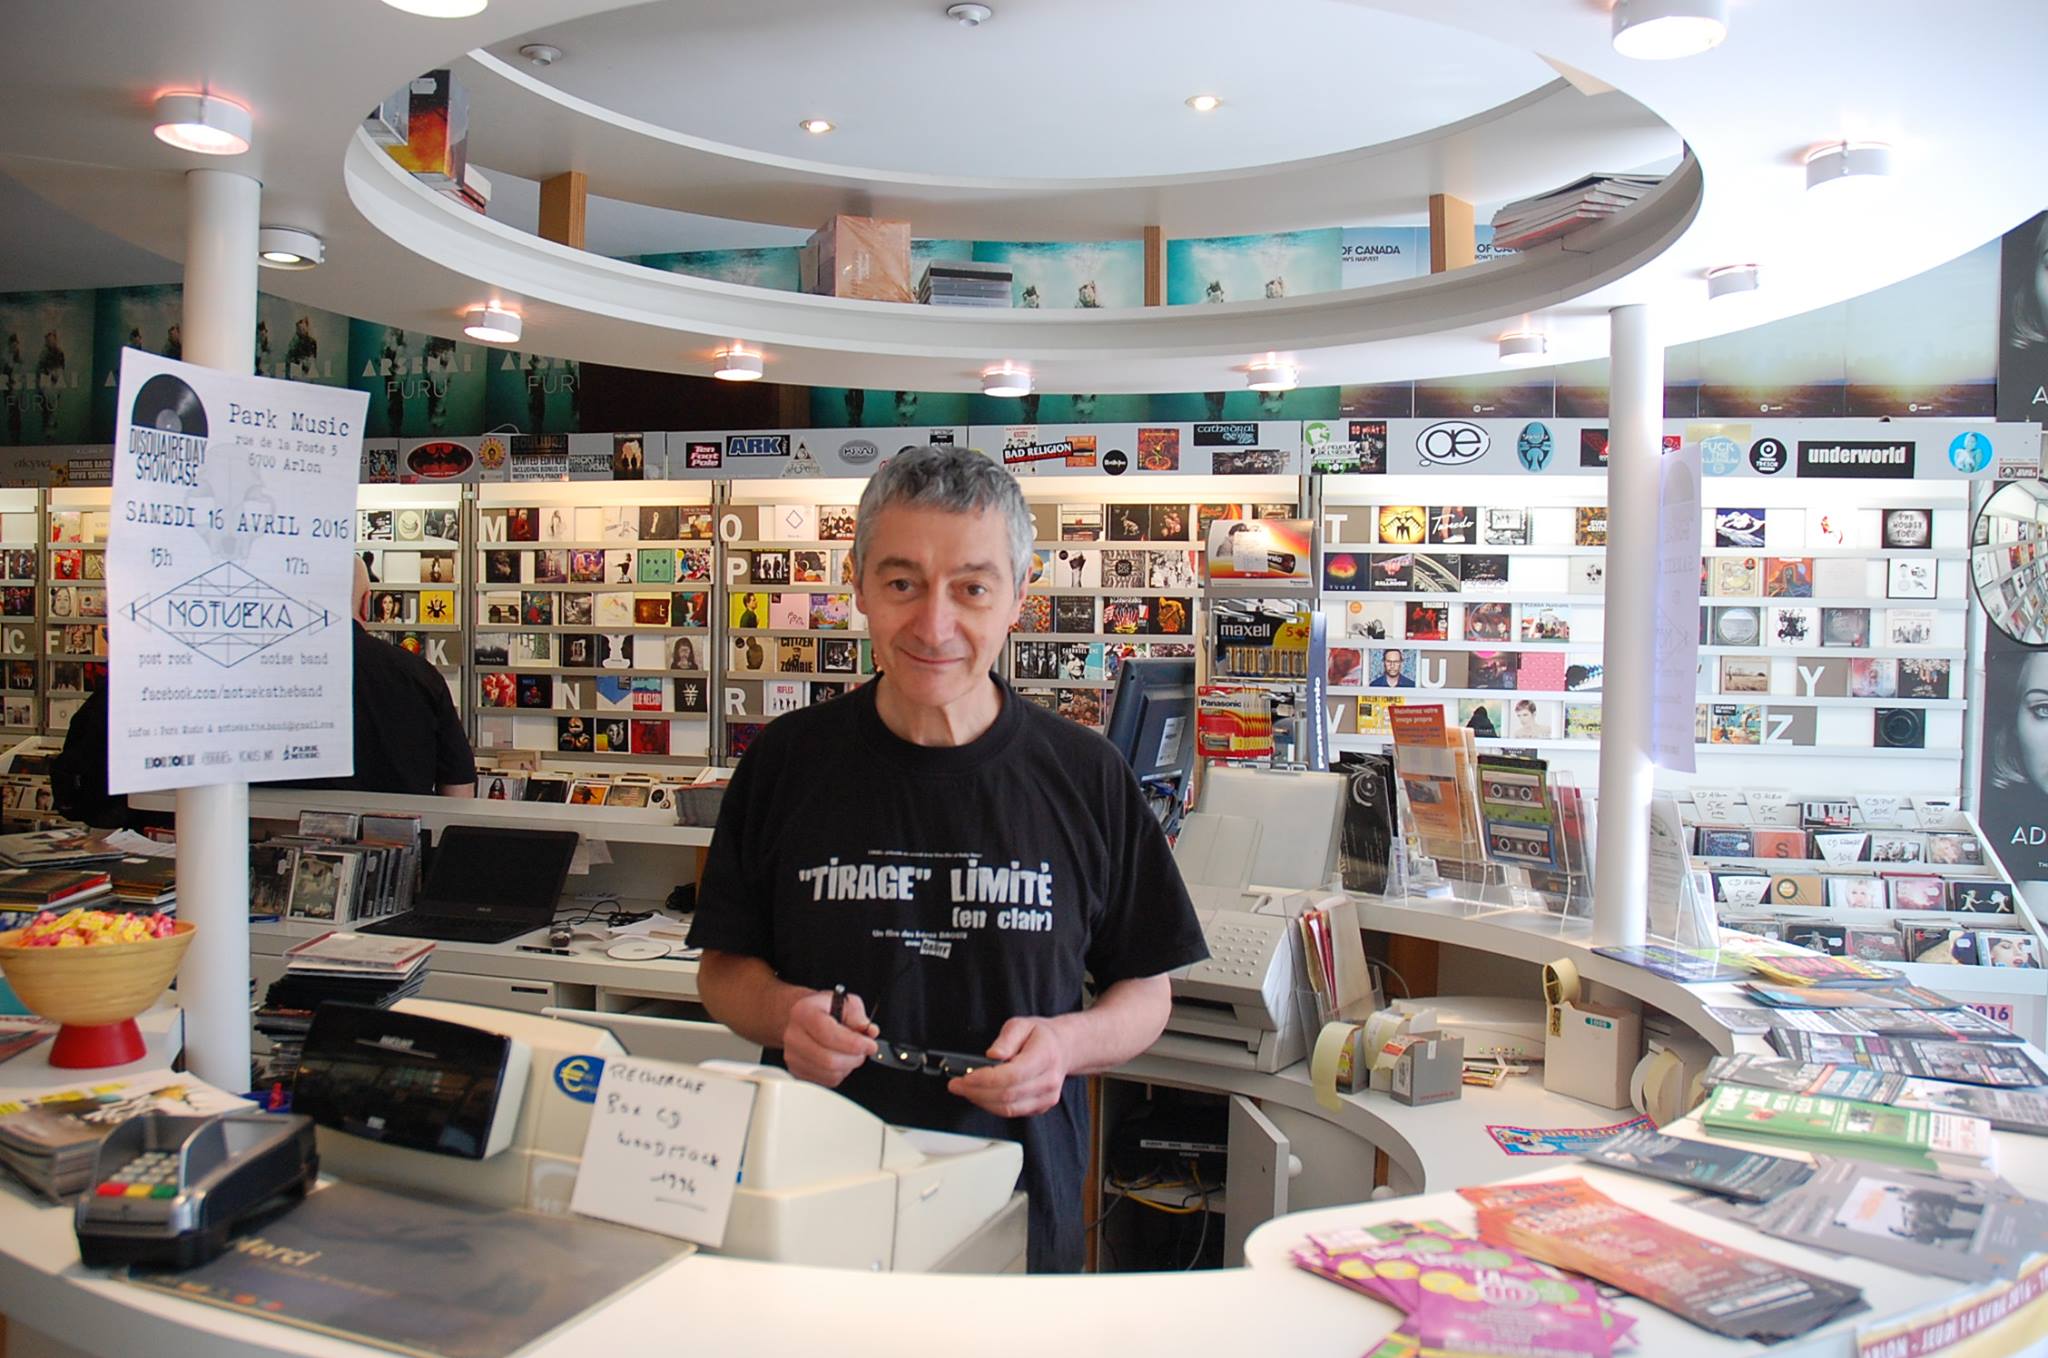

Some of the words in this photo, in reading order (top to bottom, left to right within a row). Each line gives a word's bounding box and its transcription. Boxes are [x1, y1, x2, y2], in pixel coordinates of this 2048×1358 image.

[1355, 245, 1400, 255] CANADA
[1476, 244, 1493, 253] OF
[528, 375, 580, 395] FUR
[229, 403, 277, 429] Park
[291, 412, 350, 437] Music
[235, 435, 254, 446] rue
[260, 436, 272, 448] de
[278, 439, 291, 451] la
[297, 440, 325, 455] Poste
[331, 445, 338, 456] 5
[729, 437, 781, 455] ARK
[1004, 449, 1025, 459] BAD
[1027, 443, 1072, 457] RELIGION
[1808, 445, 1906, 465] underworld
[136, 455, 199, 487] SHOWCASE
[248, 454, 277, 470] 6700
[284, 460, 323, 475] Arlon
[540, 455, 567, 465] EDITION
[126, 501, 196, 529] SAMEDI
[209, 509, 225, 531] 16
[237, 512, 300, 536] AVRIL
[312, 518, 350, 540] 2016
[482, 516, 507, 542] M
[720, 513, 742, 542] O
[1325, 514, 1348, 544] T
[151, 548, 173, 567] 15h
[286, 557, 311, 576] 17h
[727, 557, 748, 585] P
[405, 598, 417, 624] J
[8, 630, 26, 654] C
[46, 631, 61, 654] F
[1220, 623, 1271, 638] maxell
[427, 639, 449, 666] K
[780, 638, 815, 648] CITIZEN
[138, 653, 164, 666] post
[168, 652, 194, 665] rock
[260, 653, 294, 665] noise
[300, 652, 329, 665] band
[780, 661, 813, 673] ZOMBIE
[1421, 658, 1447, 689] U
[1798, 666, 1826, 697] Y
[563, 683, 581, 711] N
[725, 687, 747, 716] R
[1200, 700, 1242, 708] Panasonic
[1768, 715, 1793, 745] Z
[952, 906, 987, 929] (en
[997, 907, 1053, 932] clair)
